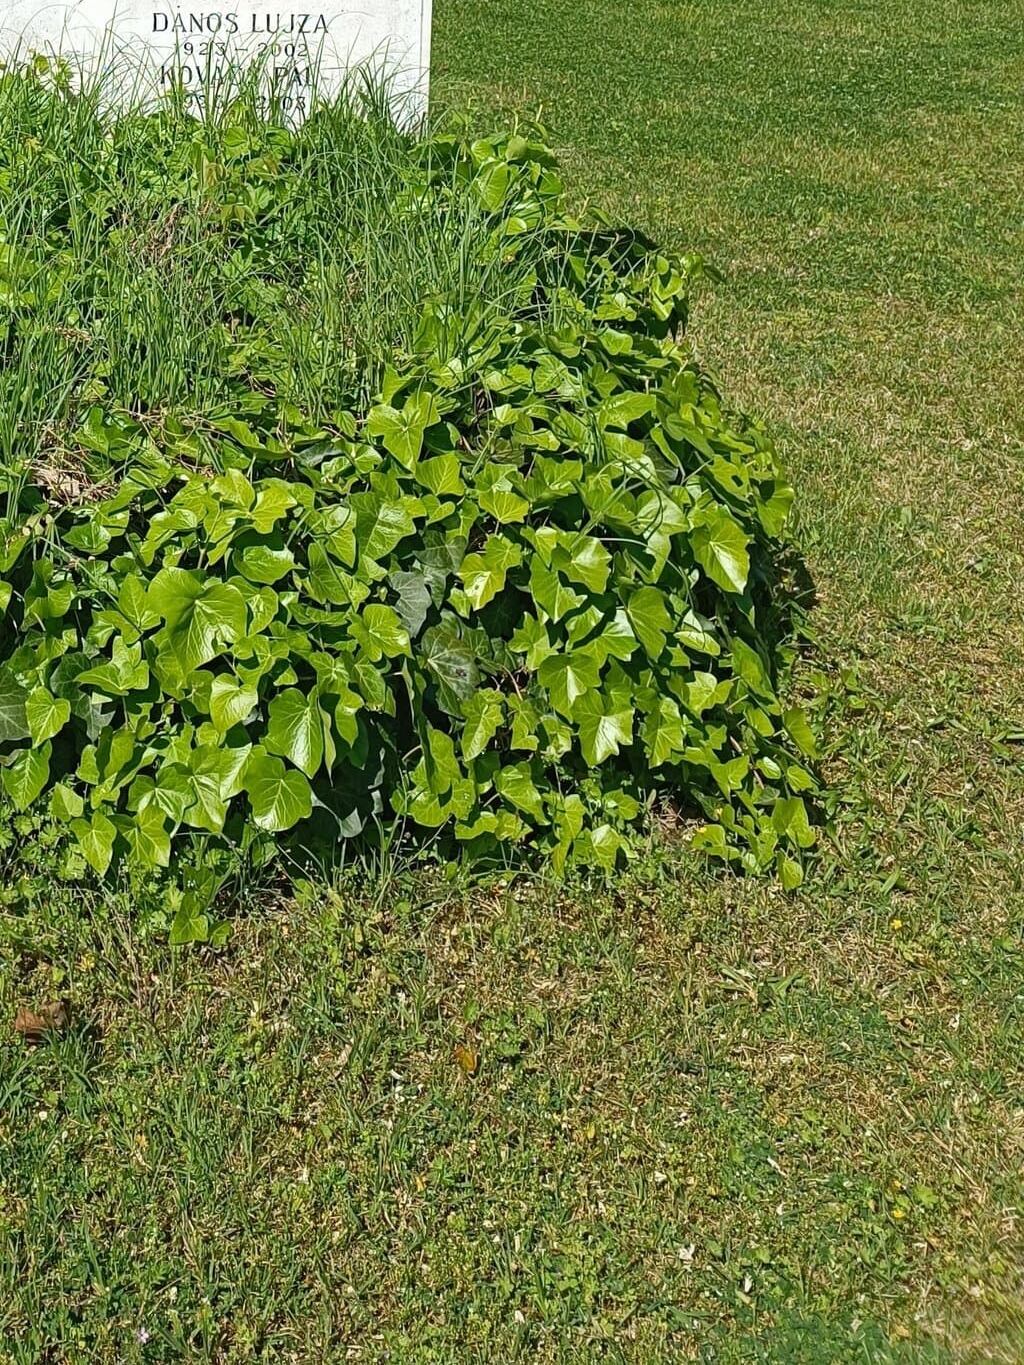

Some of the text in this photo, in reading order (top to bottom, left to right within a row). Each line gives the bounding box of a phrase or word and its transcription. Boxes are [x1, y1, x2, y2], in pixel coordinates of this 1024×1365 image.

[151, 5, 329, 34] DÁNOS LUJZA
[175, 42, 226, 57] 923
